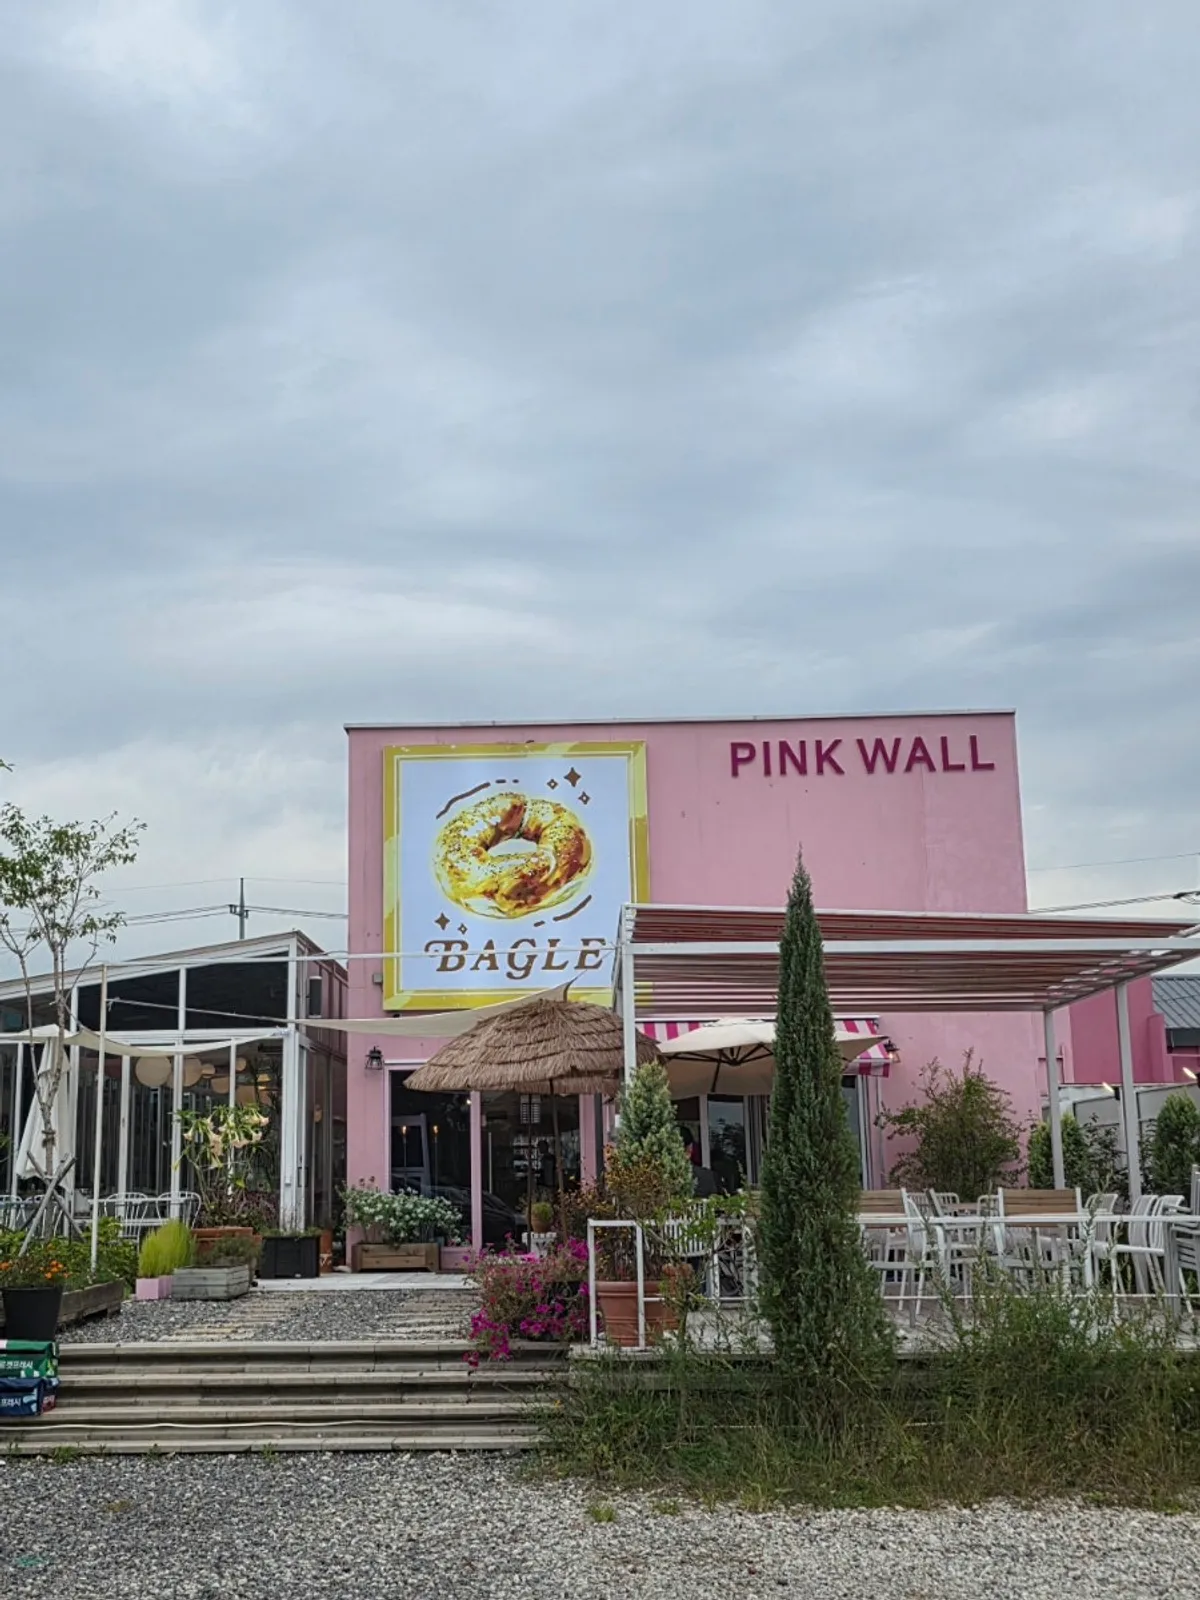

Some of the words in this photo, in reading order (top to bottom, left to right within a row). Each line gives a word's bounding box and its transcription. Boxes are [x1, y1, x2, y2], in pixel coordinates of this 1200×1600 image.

[730, 739, 845, 778] PINK
[856, 735, 995, 775] WALL
[424, 938, 606, 980] BAGLE
